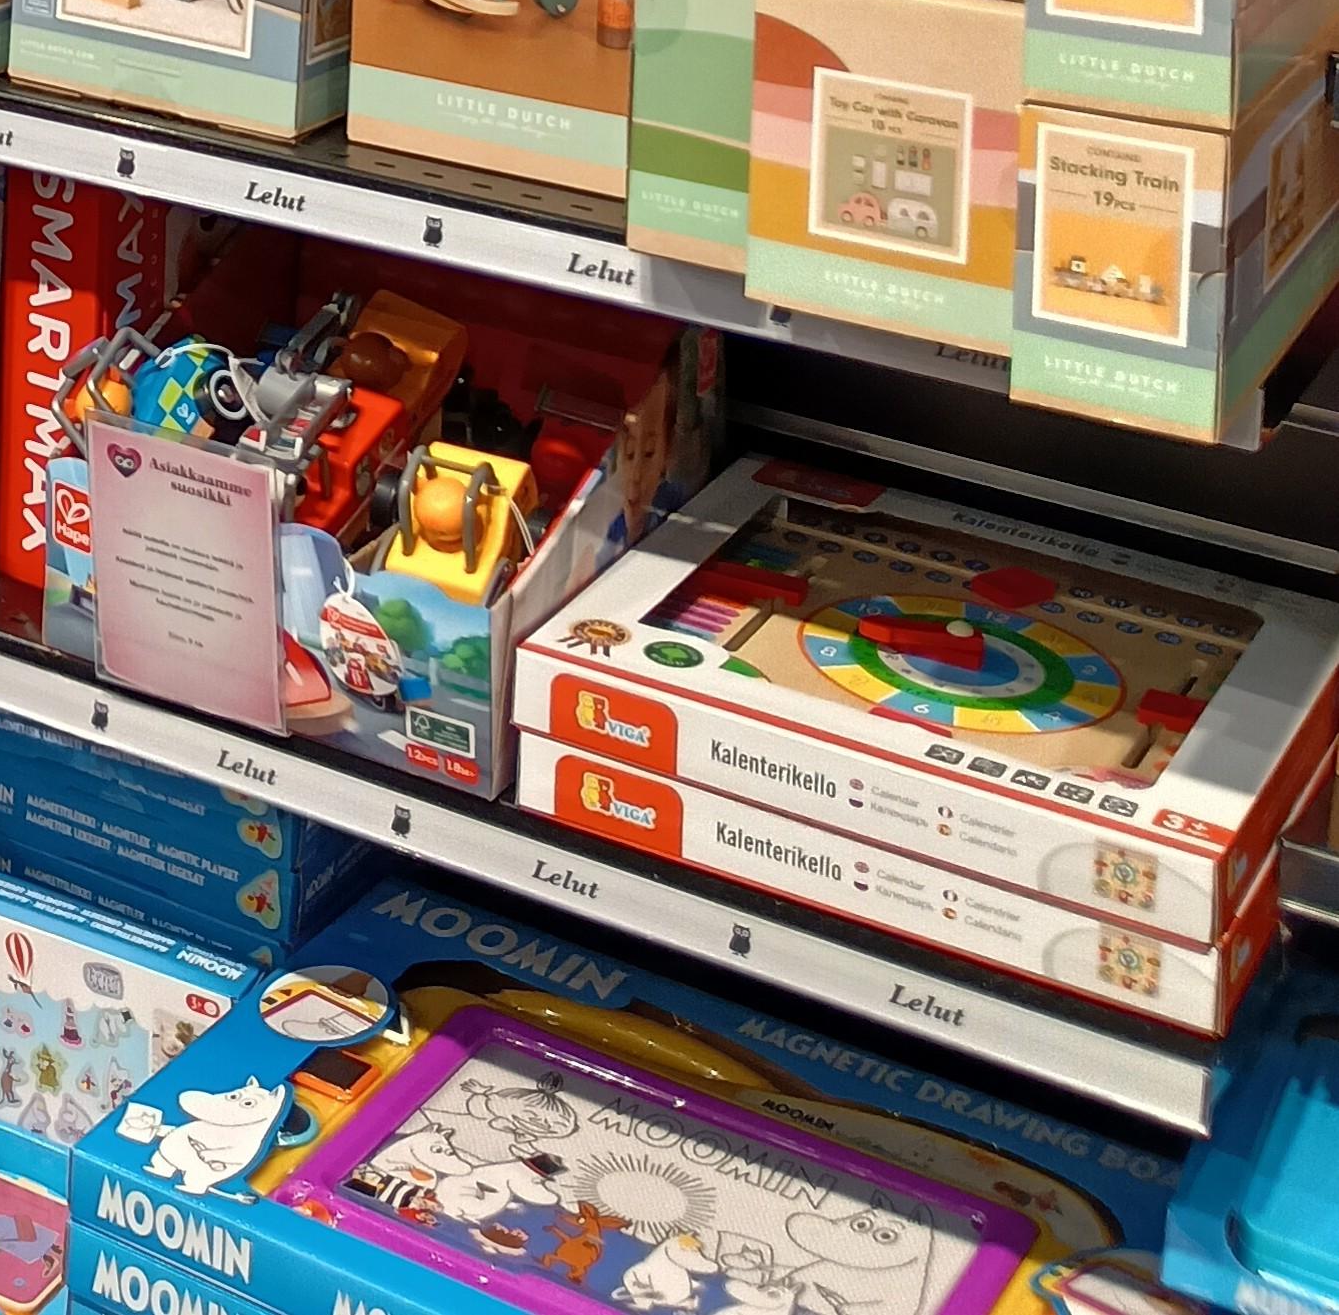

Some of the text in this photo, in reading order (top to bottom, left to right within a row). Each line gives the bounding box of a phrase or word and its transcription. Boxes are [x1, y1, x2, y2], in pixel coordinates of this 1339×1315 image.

[1059, 53, 1196, 83] LITTLE DUTCH
[436, 92, 573, 131] LITTLE DUTCH
[829, 96, 959, 131] Toy Car with Caravan
[1049, 156, 1180, 194] Stacking Train
[244, 180, 306, 212] Lelut
[566, 250, 636, 285] Lelut
[1044, 354, 1180, 395] LITTLE DUTCH
[149, 457, 252, 498] Asiakkaamme
[170, 480, 232, 507] suosikki
[607, 720, 650, 746] VIGA
[216, 749, 279, 787] Lelut
[709, 736, 838, 801] Kalenterikello
[612, 800, 656, 830] VIGA
[715, 818, 843, 885] Kalenterikello
[531, 859, 600, 900] Lelut
[372, 889, 629, 1003] MOOMIN
[887, 981, 966, 1029] Lelut
[737, 1016, 1088, 1161] MAGNETIC DRAWING
[588, 1097, 841, 1211] MOOMIN
[96, 1173, 252, 1287] MOOMIN
